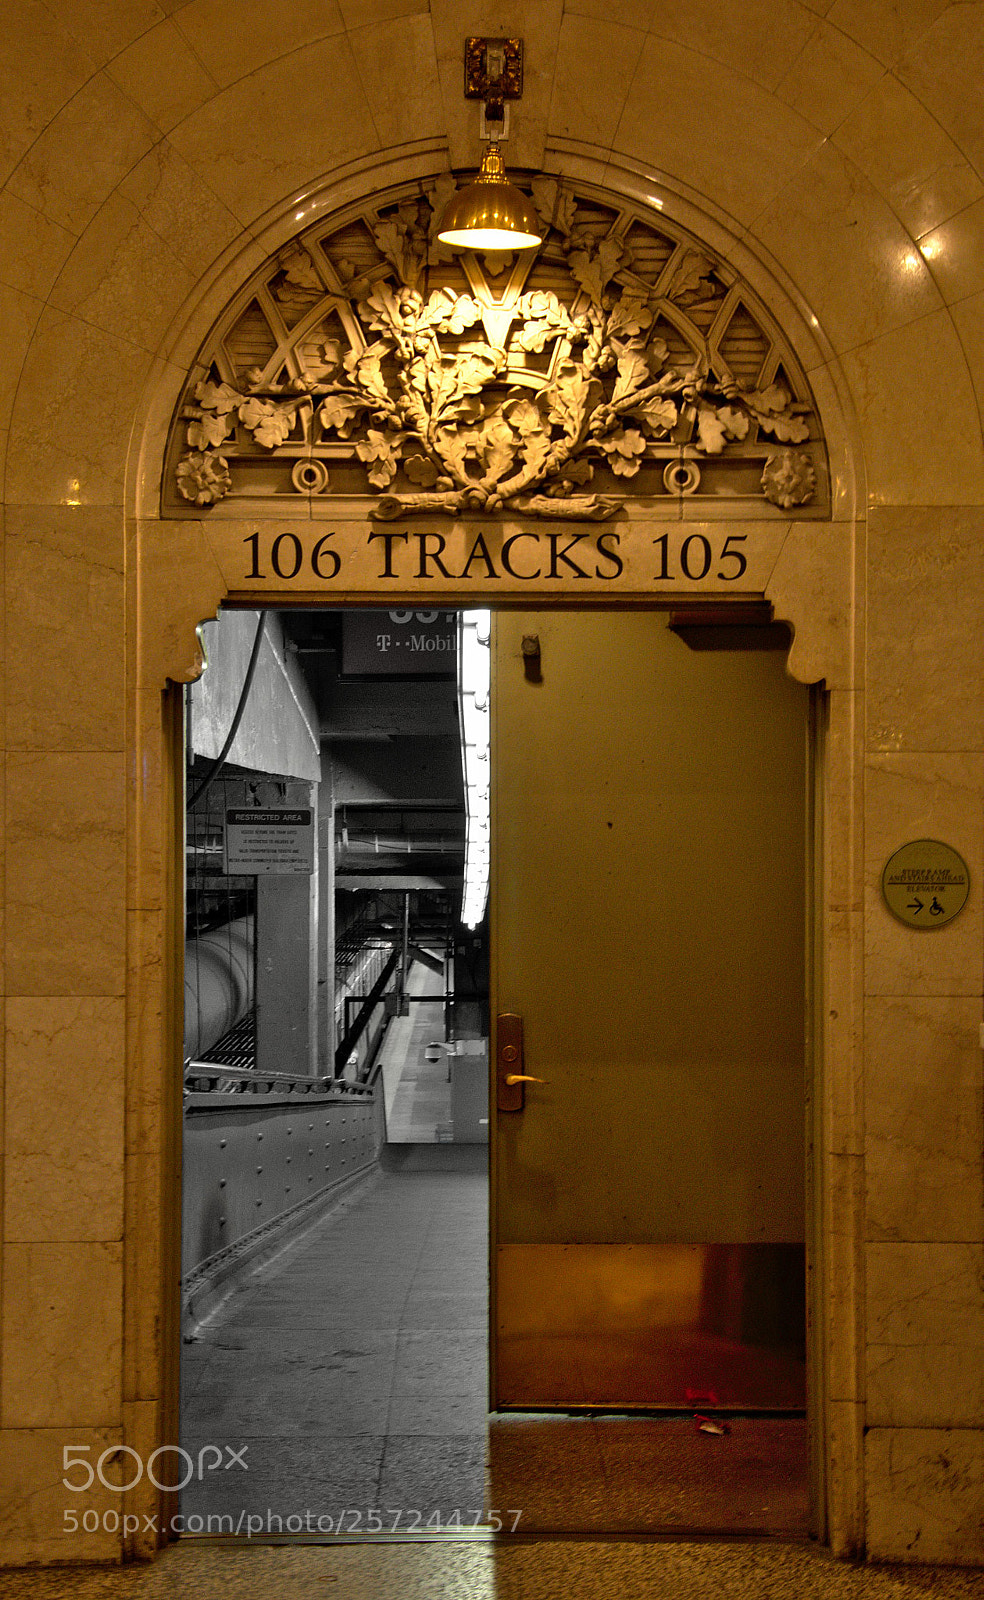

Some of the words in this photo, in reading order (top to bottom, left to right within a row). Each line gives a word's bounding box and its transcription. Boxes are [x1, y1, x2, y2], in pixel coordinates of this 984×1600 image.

[242, 531, 342, 580] 106
[367, 531, 625, 581] TRACKS
[651, 532, 749, 581] 105
[235, 813, 280, 821] RESTRICTED
